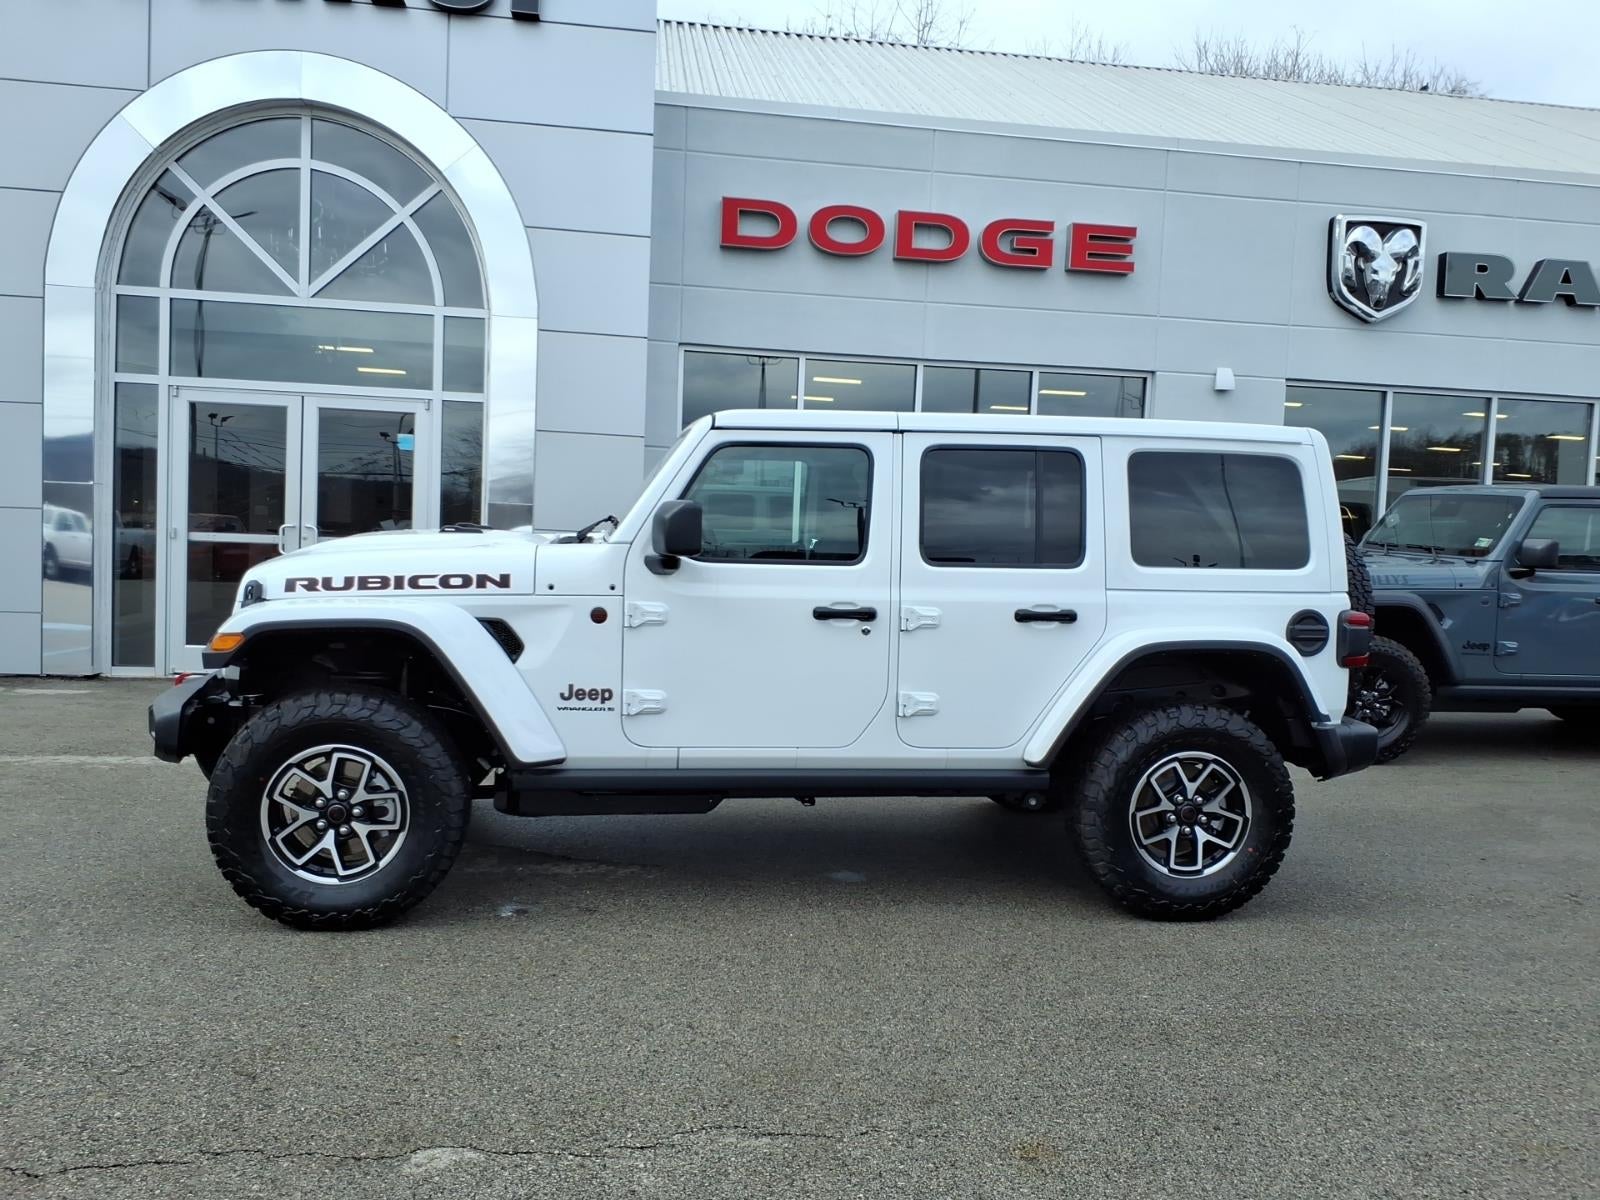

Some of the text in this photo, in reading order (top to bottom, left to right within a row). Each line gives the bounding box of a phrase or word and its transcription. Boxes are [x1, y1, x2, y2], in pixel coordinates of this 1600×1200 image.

[719, 196, 1138, 275] DODGE
[1436, 250, 1600, 309] RA
[284, 573, 511, 593] RUBICON
[1462, 640, 1490, 652] Jeep
[559, 683, 614, 705] Jeep
